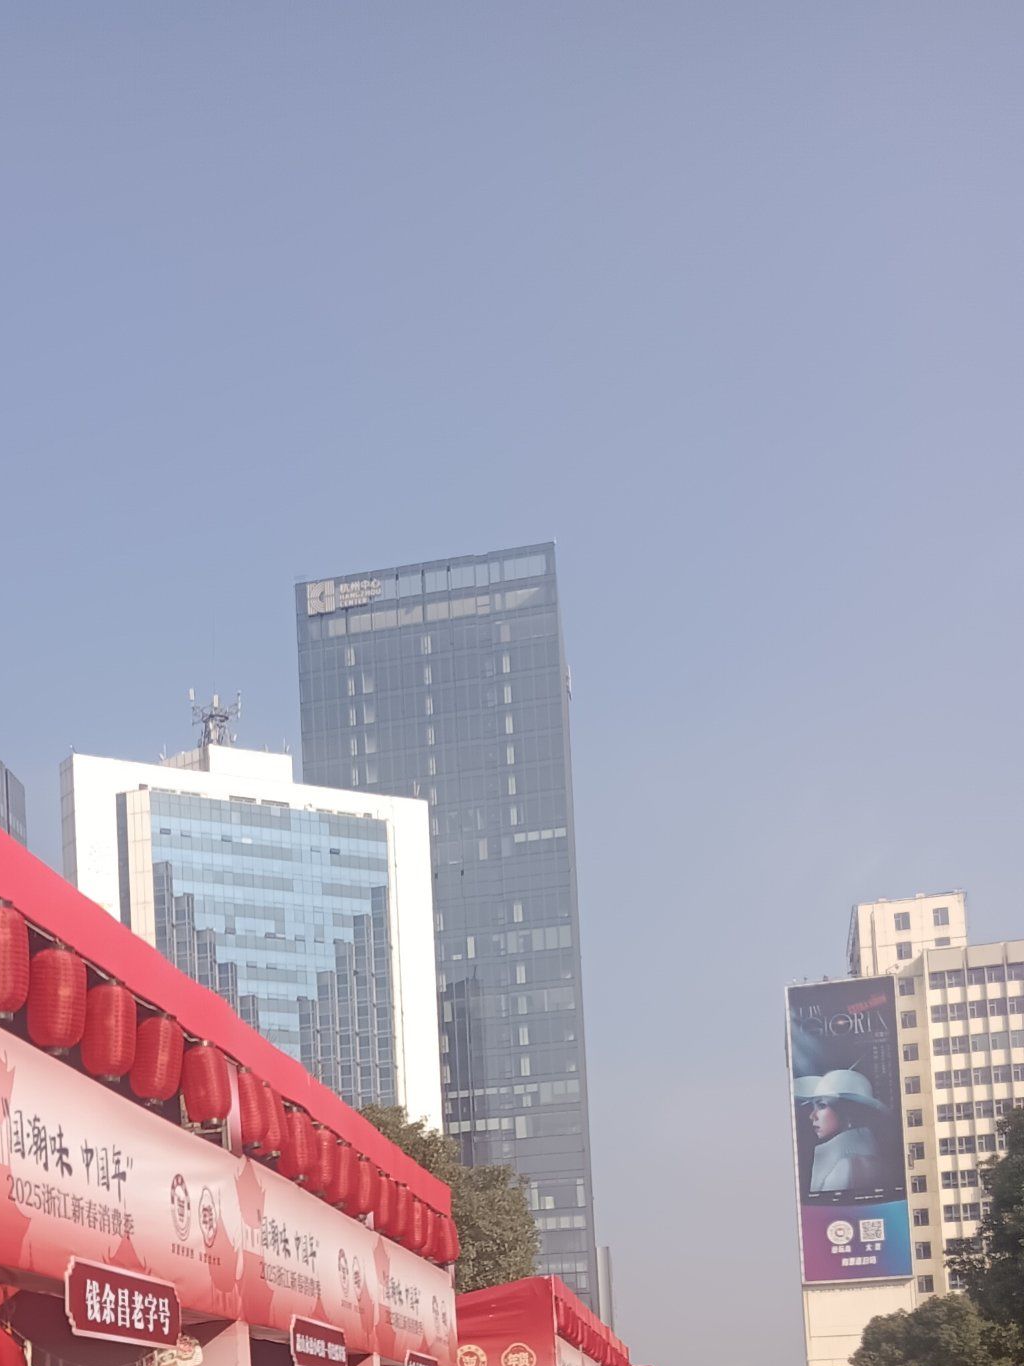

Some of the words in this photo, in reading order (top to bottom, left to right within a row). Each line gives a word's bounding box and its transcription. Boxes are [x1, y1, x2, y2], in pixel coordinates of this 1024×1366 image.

[6, 1174, 135, 1237] 2025浙江新春消费季
[85, 1278, 171, 1336] 钱余昌老字号
